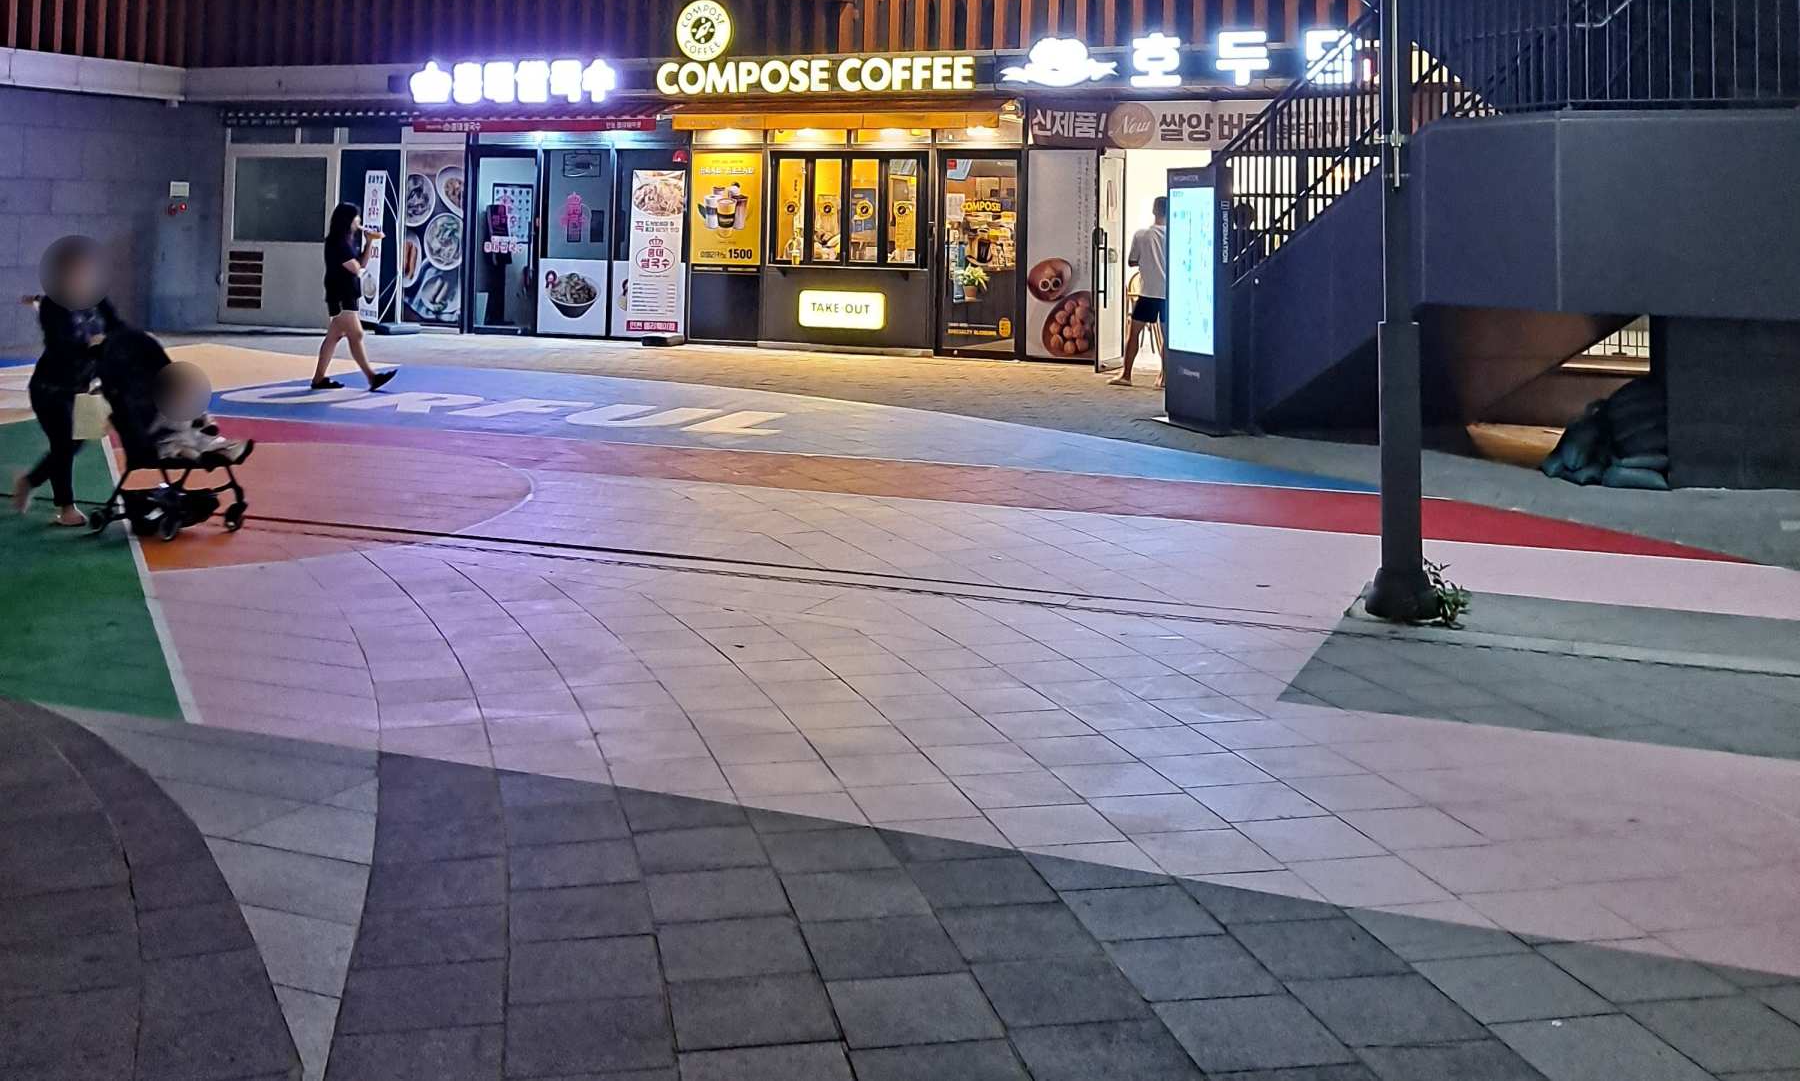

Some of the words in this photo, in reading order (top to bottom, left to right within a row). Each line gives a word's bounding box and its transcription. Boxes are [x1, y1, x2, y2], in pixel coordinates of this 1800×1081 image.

[681, 4, 726, 28] COMPOSE
[684, 39, 721, 56] COFFEE
[656, 58, 832, 96] COMPOSE
[836, 56, 976, 92] COFFEE
[1032, 109, 1107, 139] 신제품!
[1109, 115, 1153, 136] New
[640, 258, 670, 269] 쌀국수
[728, 248, 753, 260] 1500
[811, 302, 840, 314] TAKE
[845, 303, 871, 315] OUT
